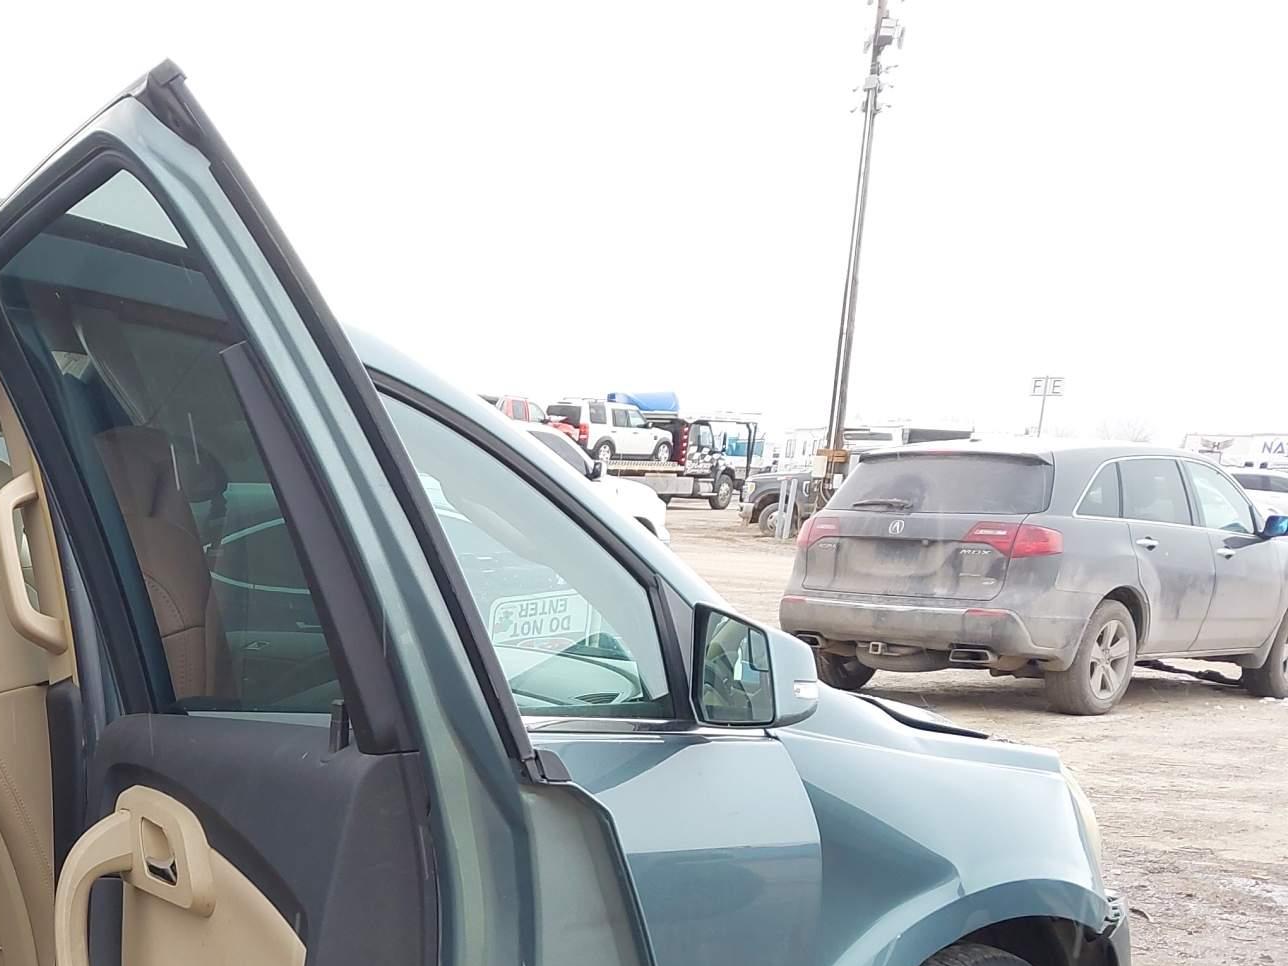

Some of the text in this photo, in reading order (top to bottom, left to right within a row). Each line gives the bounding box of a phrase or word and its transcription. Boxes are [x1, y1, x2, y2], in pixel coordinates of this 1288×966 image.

[1033, 379, 1063, 394] F E
[1262, 441, 1288, 454] NA
[518, 598, 568, 618] ENTER
[510, 615, 571, 638] DO NOT
